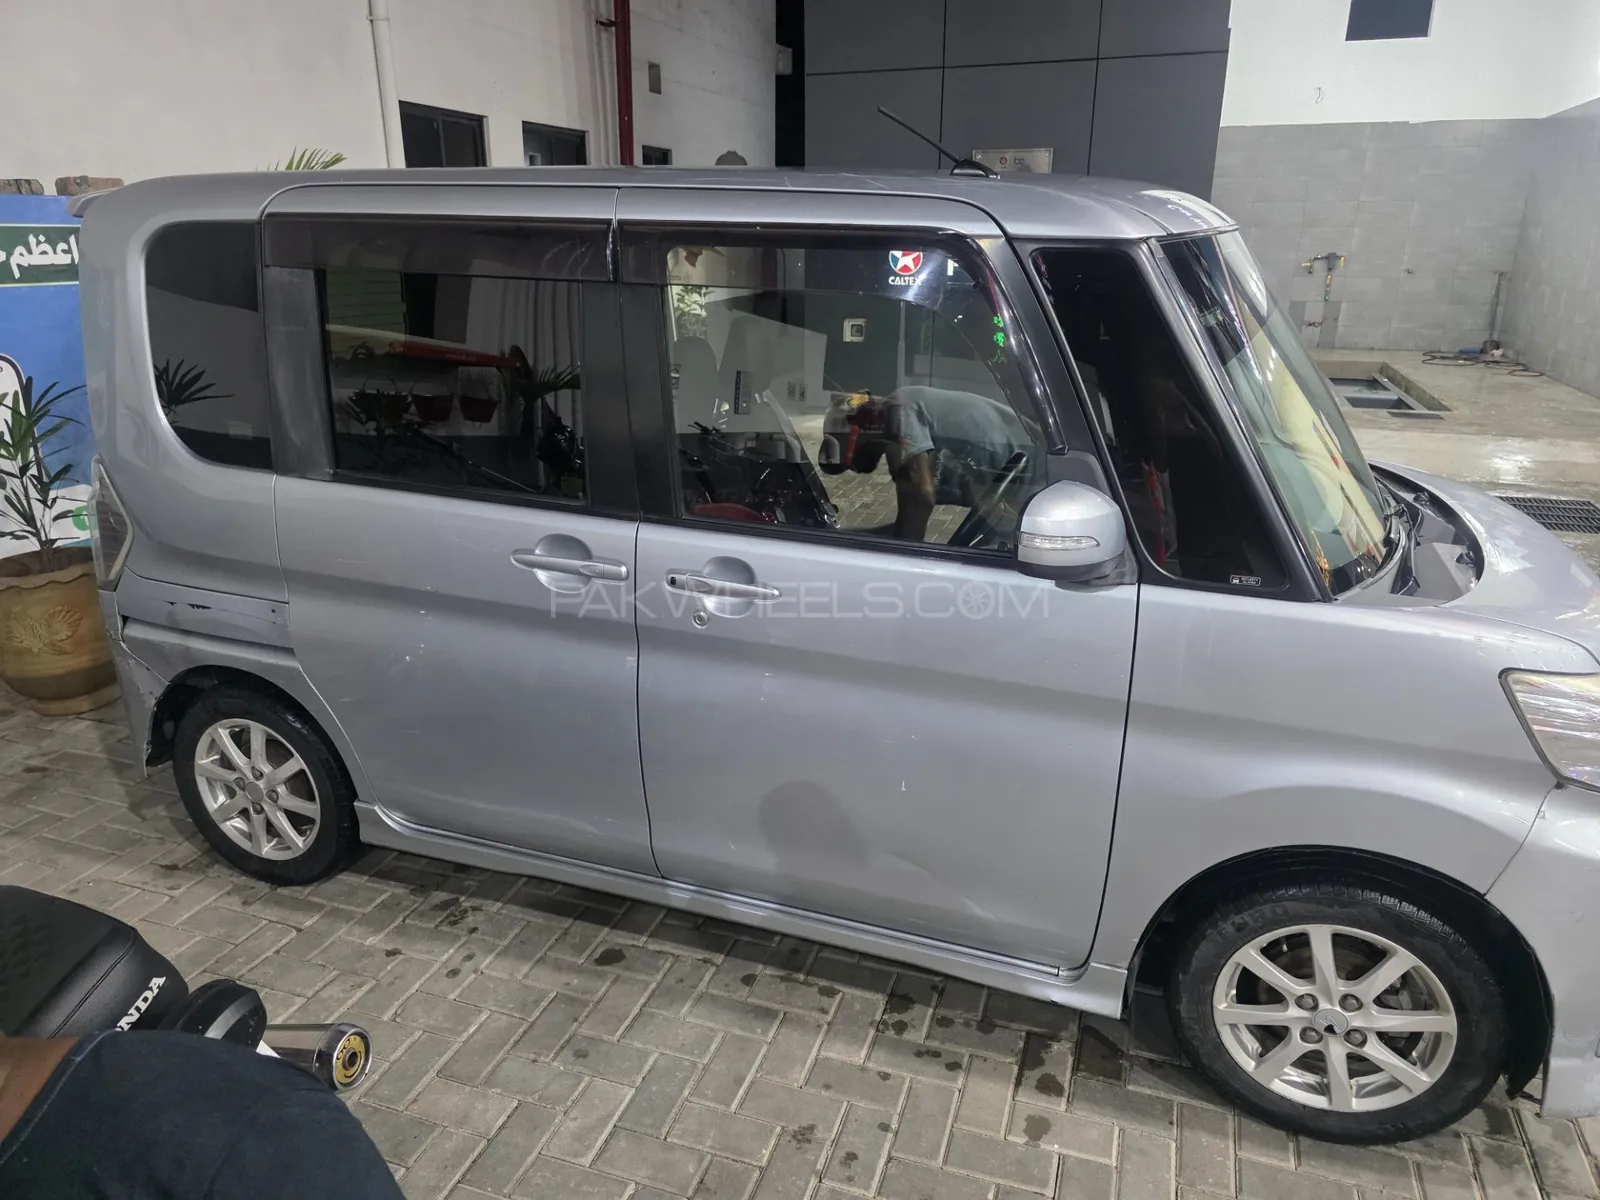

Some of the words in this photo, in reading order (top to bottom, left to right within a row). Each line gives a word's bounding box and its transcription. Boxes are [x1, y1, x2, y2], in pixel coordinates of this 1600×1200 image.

[10, 233, 79, 280] اعظم
[888, 276, 922, 286] CALTEX
[114, 976, 166, 1032] NDA
